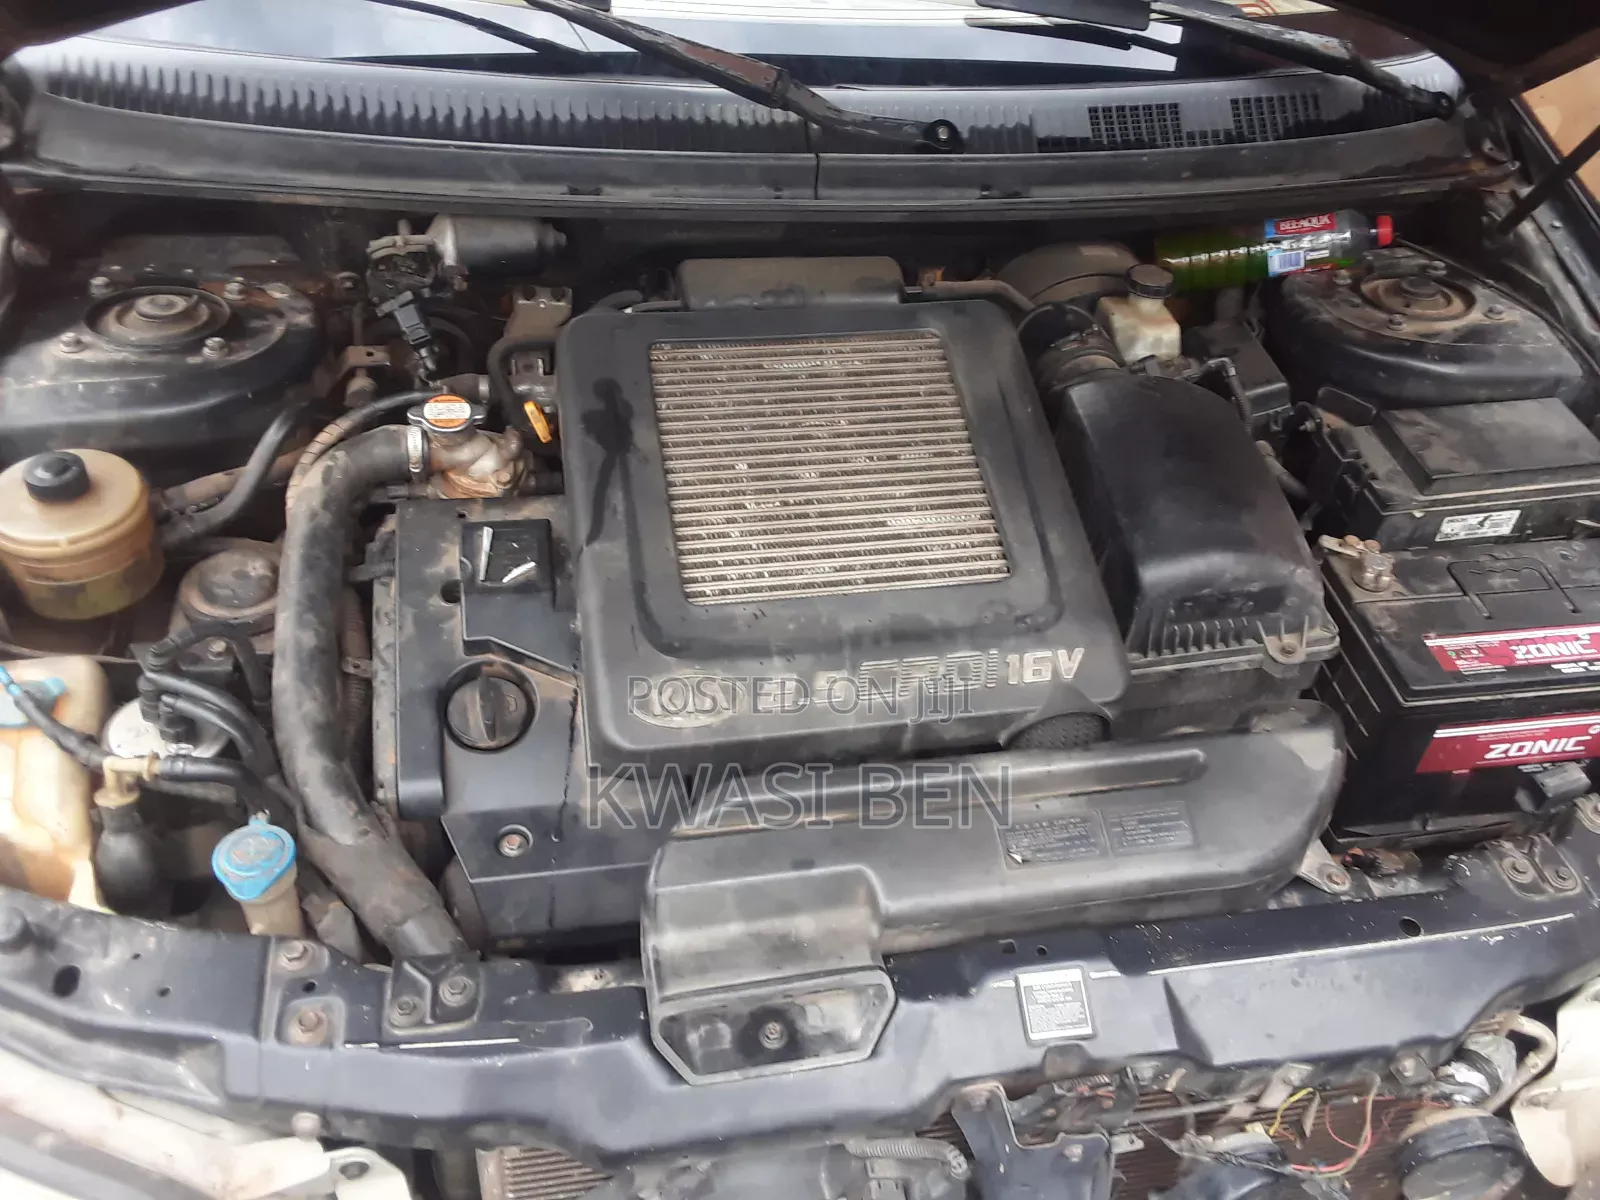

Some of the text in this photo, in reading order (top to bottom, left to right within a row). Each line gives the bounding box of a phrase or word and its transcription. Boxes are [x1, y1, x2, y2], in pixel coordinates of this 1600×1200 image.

[1510, 638, 1597, 659] ZONIC
[1005, 647, 1084, 684] 16V
[1484, 735, 1592, 759] ZONIC
